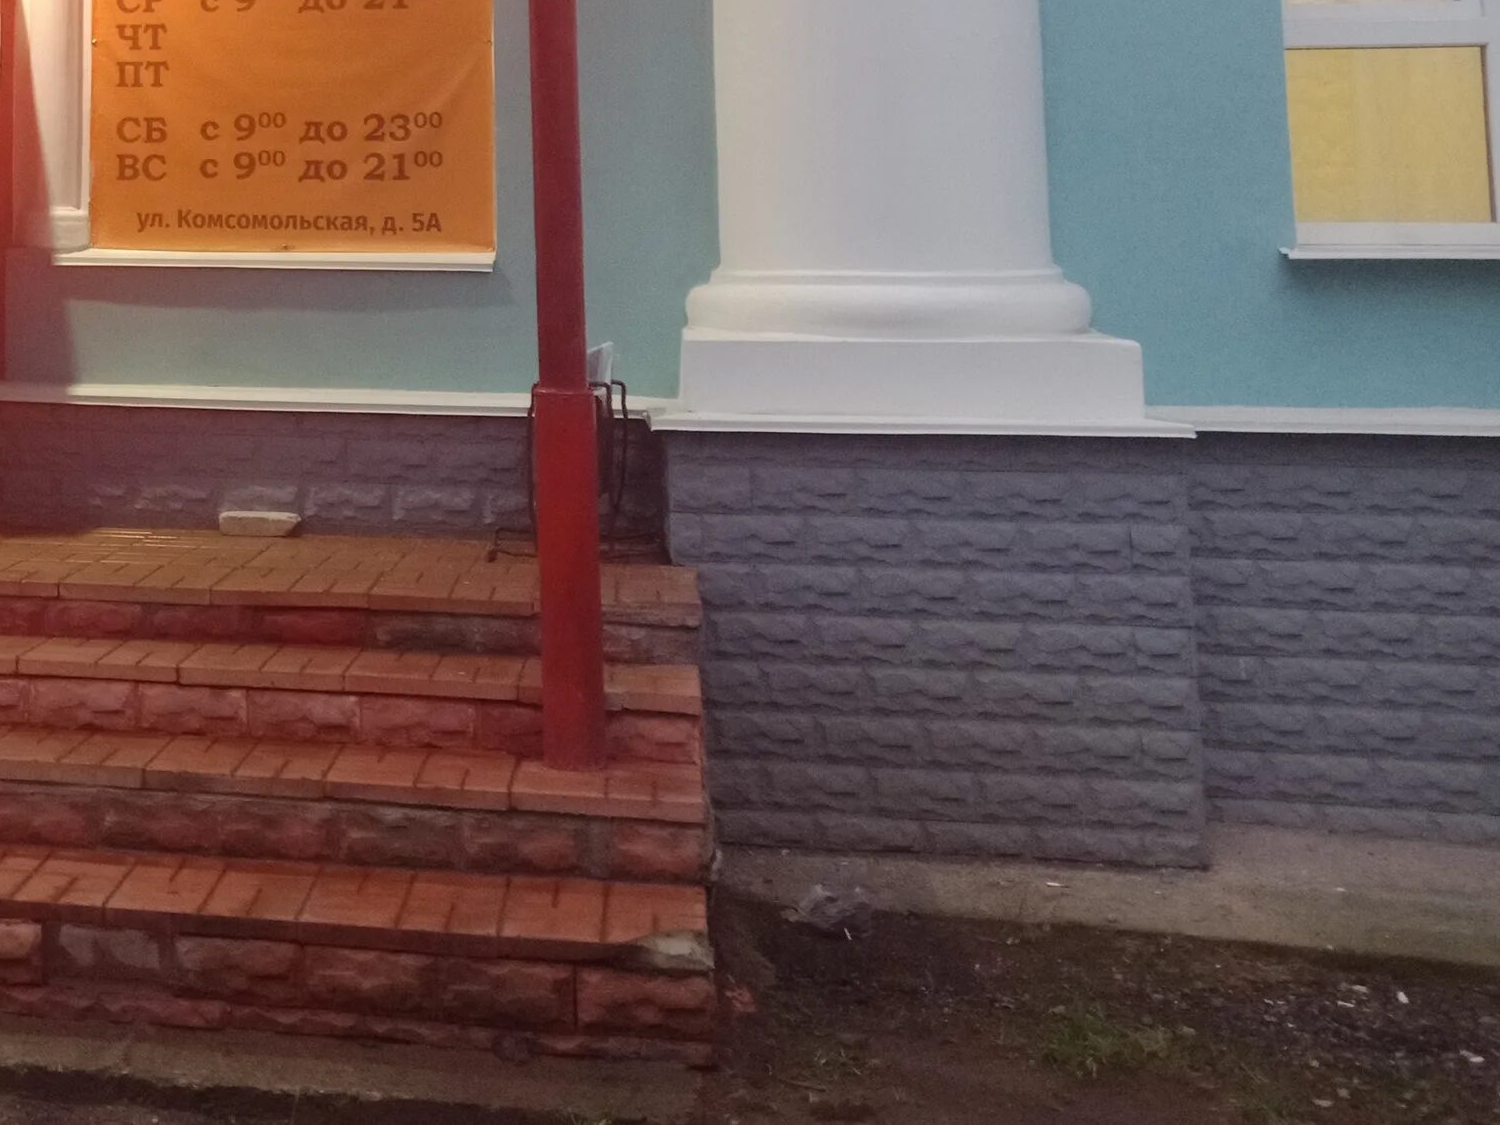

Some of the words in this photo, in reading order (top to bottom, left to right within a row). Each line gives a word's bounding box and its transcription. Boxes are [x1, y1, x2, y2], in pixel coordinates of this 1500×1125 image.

[116, 24, 167, 51] ЧТ
[116, 61, 170, 88] ПТ
[116, 116, 167, 144] СБ
[200, 120, 220, 142] с
[299, 119, 348, 144] до
[116, 154, 167, 181] ВС
[200, 158, 219, 179] с
[299, 158, 348, 182] до
[136, 210, 170, 232] ул.
[177, 210, 375, 235] Комсомольская,
[382, 216, 404, 235] д.
[412, 212, 442, 233] 5А
